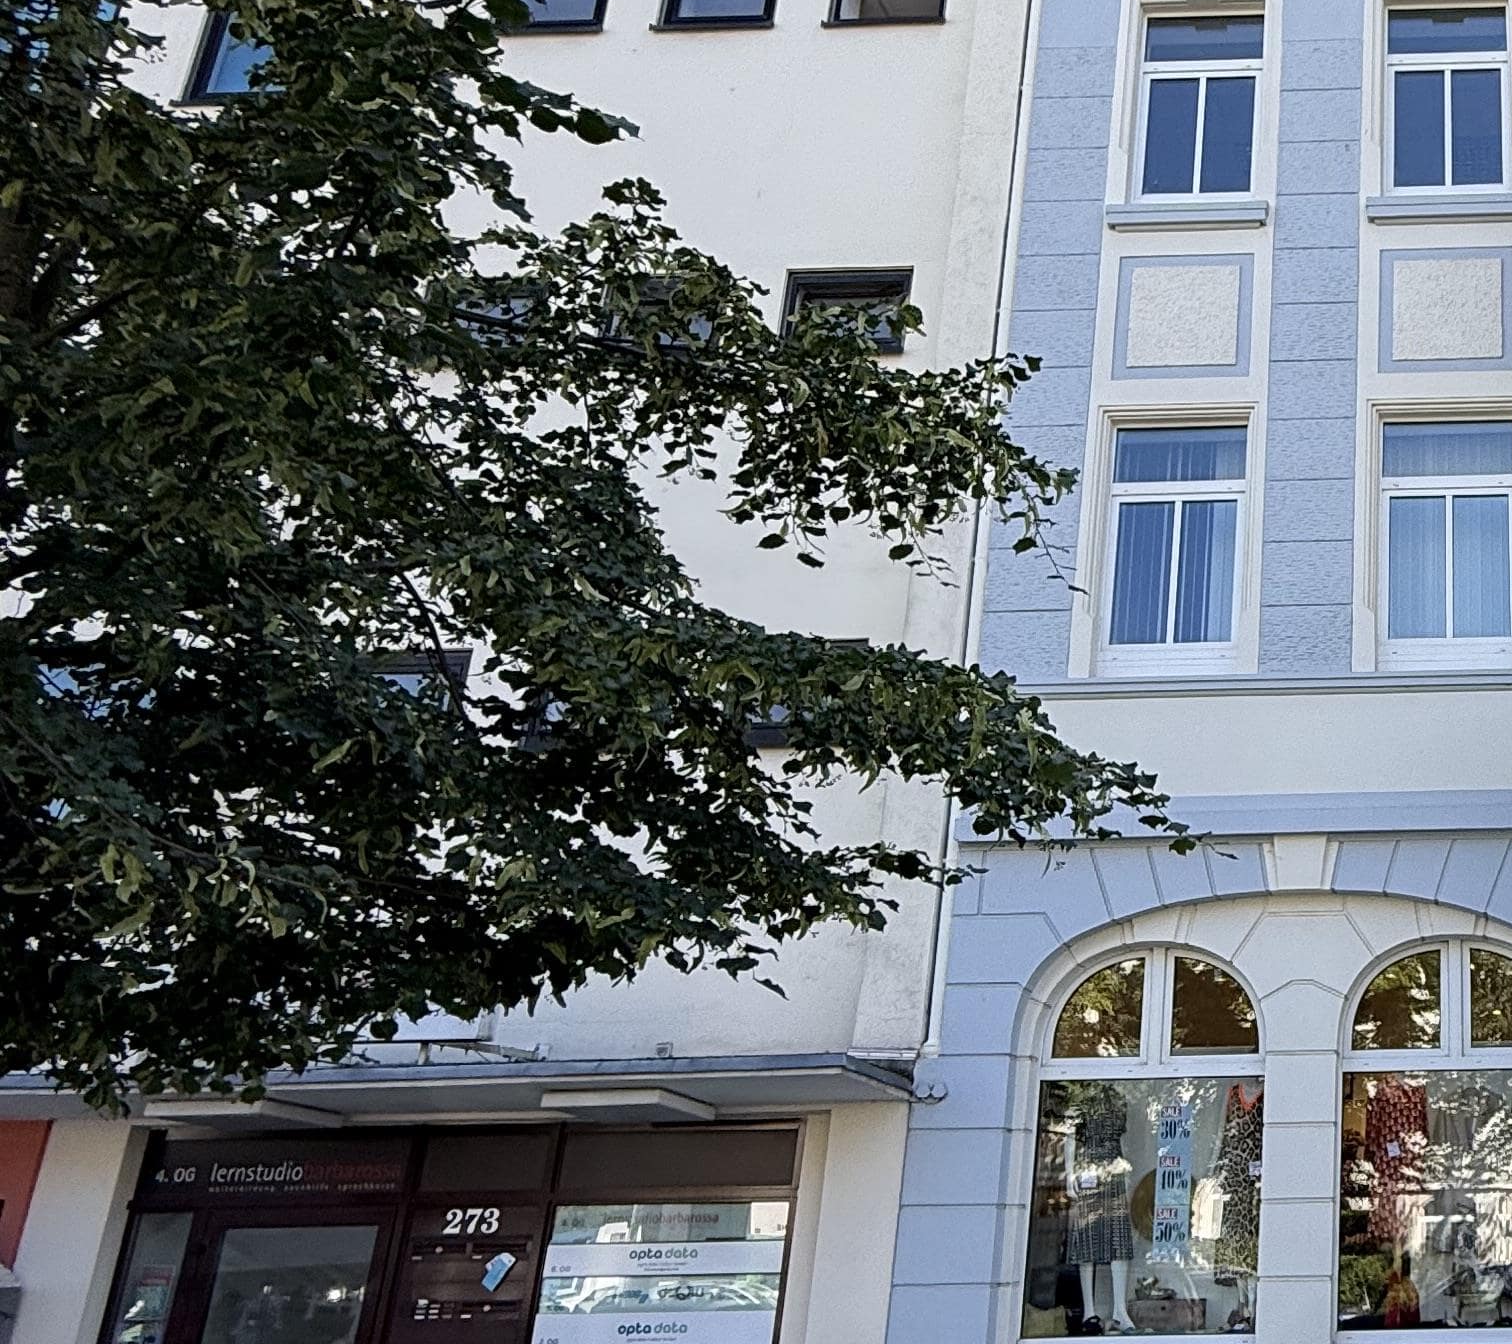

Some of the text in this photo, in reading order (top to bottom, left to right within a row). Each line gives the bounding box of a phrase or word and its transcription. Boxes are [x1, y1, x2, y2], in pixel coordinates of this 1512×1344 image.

[1161, 1106, 1180, 1117] SALE
[1160, 1119, 1190, 1140] 30%
[1160, 1157, 1179, 1167] SALE
[174, 1166, 196, 1182] OG
[442, 1207, 500, 1235] 273
[1156, 1209, 1177, 1219] SALE
[1155, 1222, 1186, 1242] 50%
[629, 1247, 698, 1261] opta data
[617, 1321, 688, 1336] opta data
